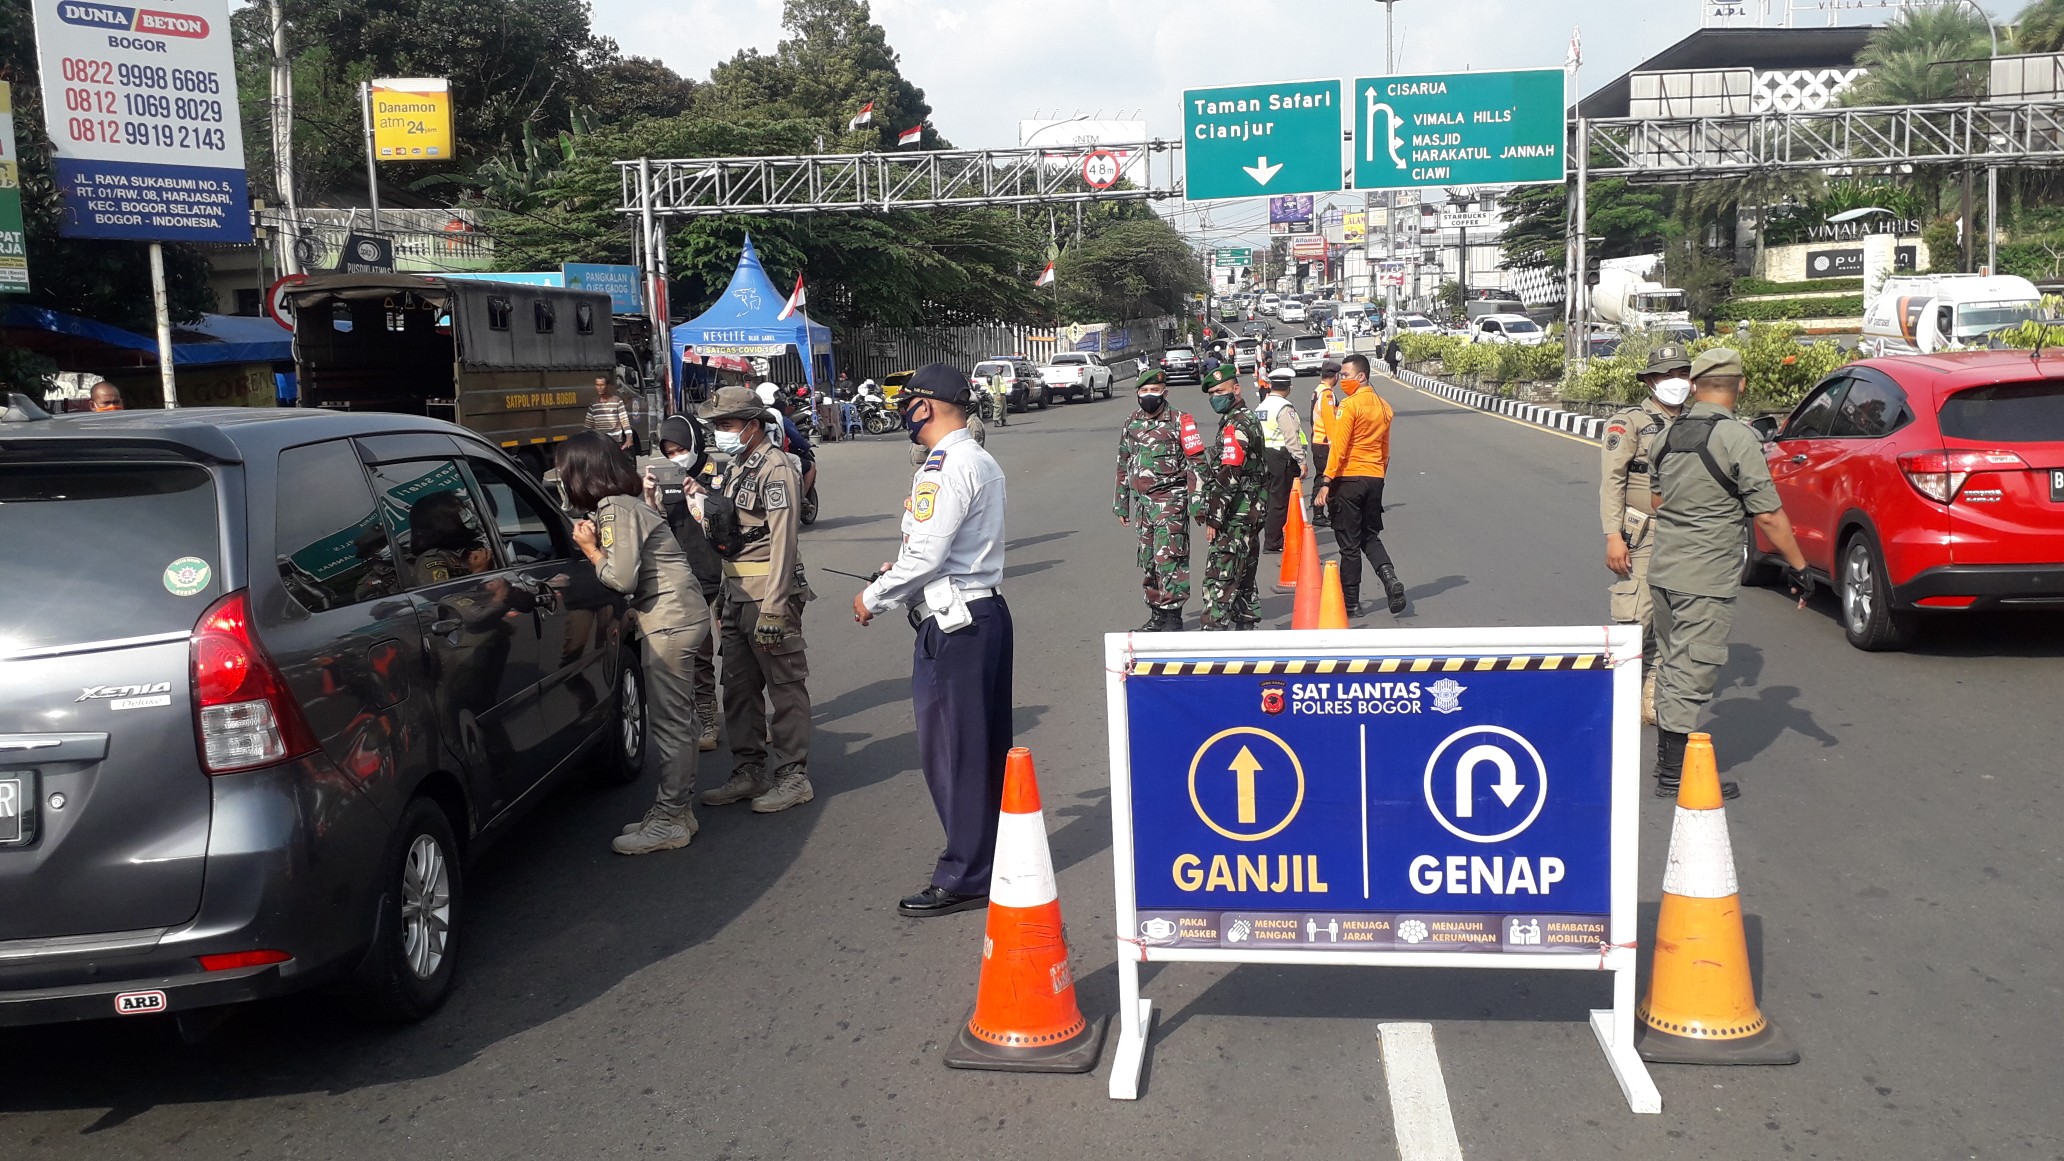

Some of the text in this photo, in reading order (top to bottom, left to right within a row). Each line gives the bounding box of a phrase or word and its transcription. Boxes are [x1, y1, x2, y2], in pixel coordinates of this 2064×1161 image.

[65, 5, 201, 33] DUNIA BETON
[108, 35, 167, 53] BOGOR
[62, 57, 220, 94] 0822 9998 6685
[1387, 82, 1447, 96] CISARUA
[65, 87, 222, 122] 0812 1069 8029
[379, 102, 436, 113] Danamon
[1194, 90, 1331, 116] Taman Safari
[380, 117, 405, 128] atm
[407, 121, 425, 134] 24
[1413, 112, 1465, 126] VIMALA
[69, 117, 226, 151] 0812 9919 2143
[1195, 120, 1274, 142] Cianjur
[1412, 133, 1461, 146] MASJID
[1412, 145, 1555, 162] HARAKATUL JANNAH
[1412, 167, 1450, 180] CIAWI
[74, 173, 233, 193] JL. RAYA SUKABUMI NO. 5,
[77, 187, 233, 205] RT. 01/RW. 08, HARJASARI,
[88, 200, 226, 217] KEC. BOGOR SELATAN,
[95, 213, 142, 225] BOGOR
[152, 216, 222, 229] INDONESIA.
[1808, 221, 1871, 240] VIMALA
[586, 272, 627, 283] PANGKALAN
[605, 284, 628, 294] GADOG
[703, 330, 745, 342] NESLITE
[705, 346, 736, 354] SATGAS
[506, 392, 577, 409] SATPOL PP KAB. BOGOR
[1292, 682, 1421, 700] SAT LANTAS
[1293, 700, 1422, 715] POLRES BOGOR
[1172, 853, 1328, 894] GANJIL
[1408, 855, 1565, 896] GENAP
[1179, 918, 1207, 927] PAKAI
[1254, 919, 1298, 929] MENCUCI
[1343, 921, 1390, 931] MENJAGA
[1432, 922, 1483, 931] MENJAUHI
[1547, 923, 1605, 932] MEMBATASI
[1179, 929, 1217, 939] MASKER
[1255, 931, 1296, 940] TANGAN
[1343, 932, 1374, 941] JARAK
[1432, 933, 1496, 943] KERUMUNAN
[1547, 933, 1600, 943] MOBILITAS
[123, 996, 160, 1009] ARB
